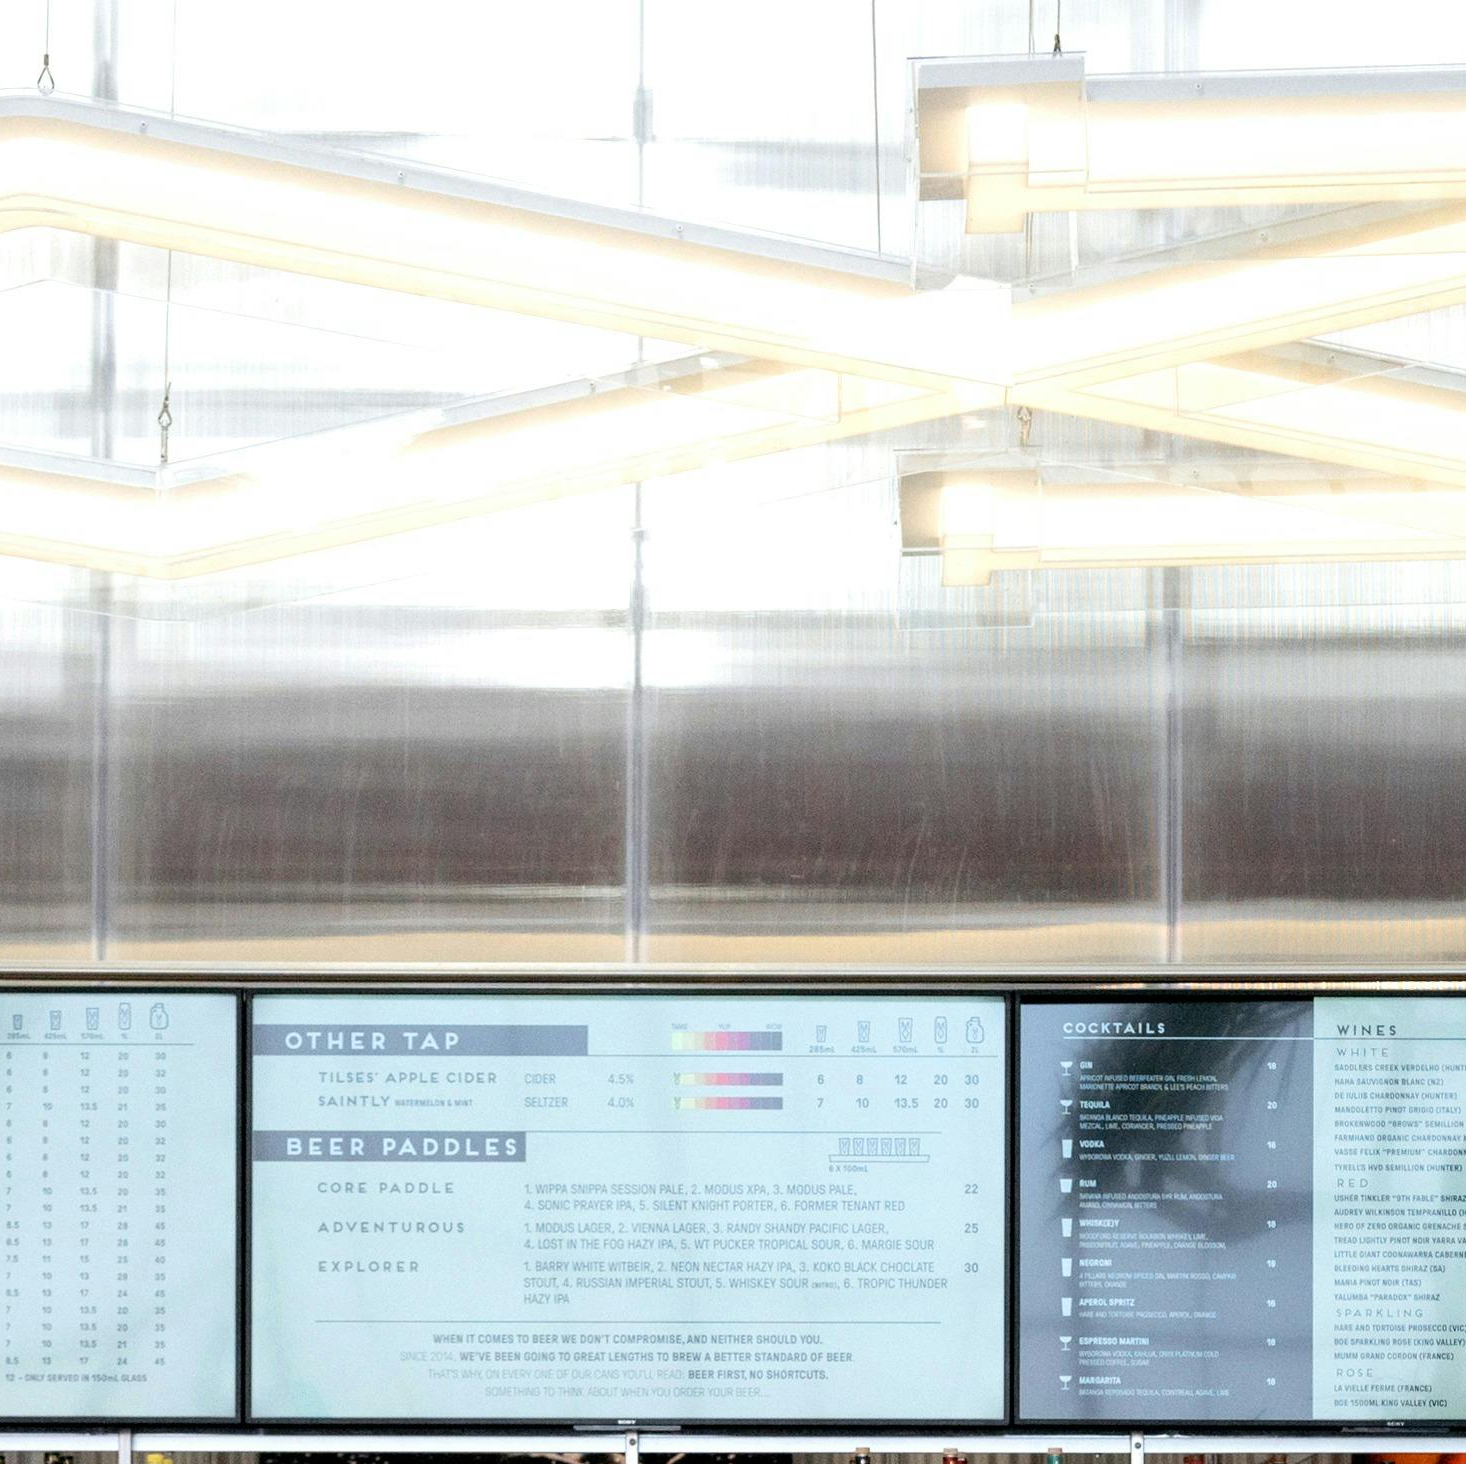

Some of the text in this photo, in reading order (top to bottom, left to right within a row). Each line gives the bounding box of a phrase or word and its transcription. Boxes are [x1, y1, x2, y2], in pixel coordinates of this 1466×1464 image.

[1063, 1022, 1165, 1034] COCKTAILS
[1337, 1025, 1396, 1036] WINES
[285, 1032, 459, 1049] OTHER TAP
[1336, 1048, 1388, 1057] WHITE
[385, 1072, 439, 1083] APPLE
[446, 1072, 497, 1083] CIDER
[524, 1073, 556, 1084] CIDER
[818, 1075, 979, 1085] 6 8 12 20 30
[318, 1096, 390, 1106] SAINTLY
[524, 1097, 569, 1108] SELTZER
[817, 1098, 979, 1108] 7 10 13.5 20 30
[1080, 1101, 1110, 1109] TEQUILA
[287, 1138, 517, 1155] BEER PADDLES
[1079, 1140, 1104, 1148] VODKA
[318, 1182, 454, 1194] CORE PADDLE
[1338, 1179, 1368, 1188] RED
[965, 1185, 978, 1194] 22
[318, 1222, 465, 1233] ADVENTUROUS
[965, 1223, 978, 1234] 25
[318, 1261, 419, 1272] EXPLORER
[965, 1263, 978, 1273] 30
[1079, 1298, 1135, 1306] APEROL SPRITZ
[1336, 1309, 1423, 1318] SPARKLING
[433, 1335, 822, 1345] WHEN IT COMES TO BEER WE DON'T COMPROMISE, AND NEITHER SHOULD YOU.
[1079, 1337, 1149, 1345] ESPRESSO MARTINI
[460, 1352, 823, 1362] WE'VE BEEN GOING TO GREAT LENGTHS TO BREW A BETTER STANDARD OF
[688, 1370, 828, 1381] BEER FIRST, NO SHORTCUTS.
[1337, 1369, 1373, 1377] ROSE
